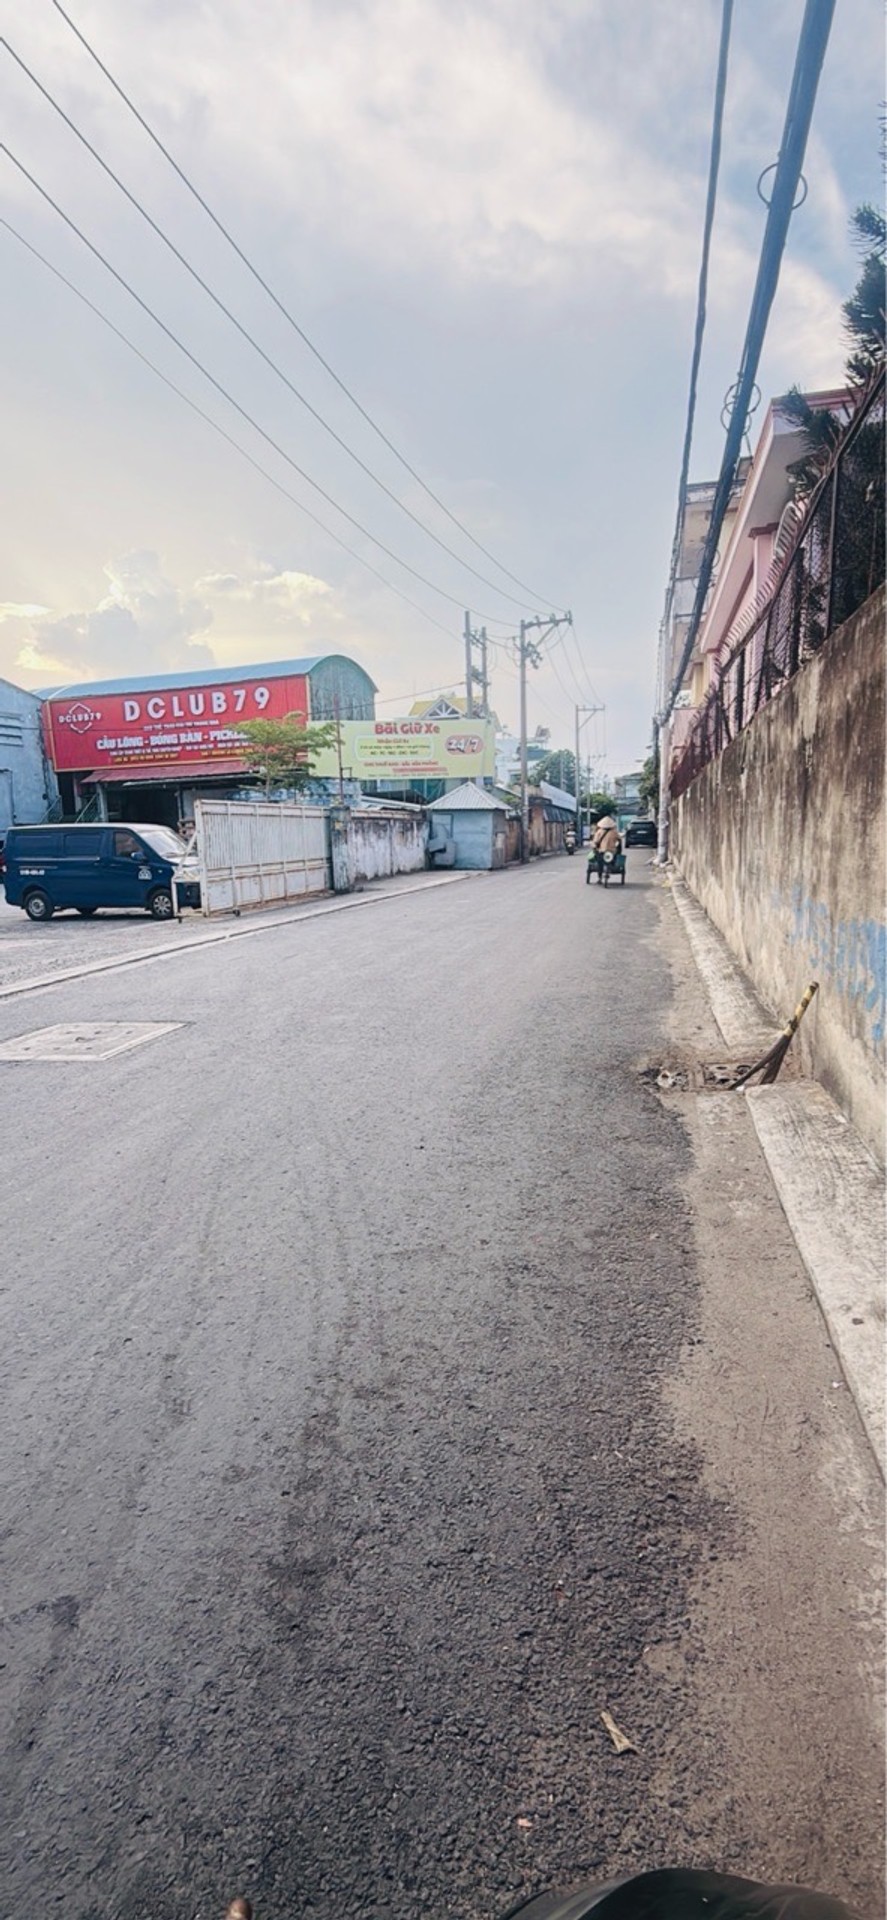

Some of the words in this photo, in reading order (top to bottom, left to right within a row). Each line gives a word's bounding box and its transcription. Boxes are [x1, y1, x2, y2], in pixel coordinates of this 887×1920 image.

[124, 686, 270, 722] DCLUB79
[58, 712, 101, 723] DCLUB79
[375, 722, 398, 734] Bãi
[400, 721, 422, 734] Giữ
[424, 722, 440, 734] Xe
[447, 736, 479, 754] 24/7
